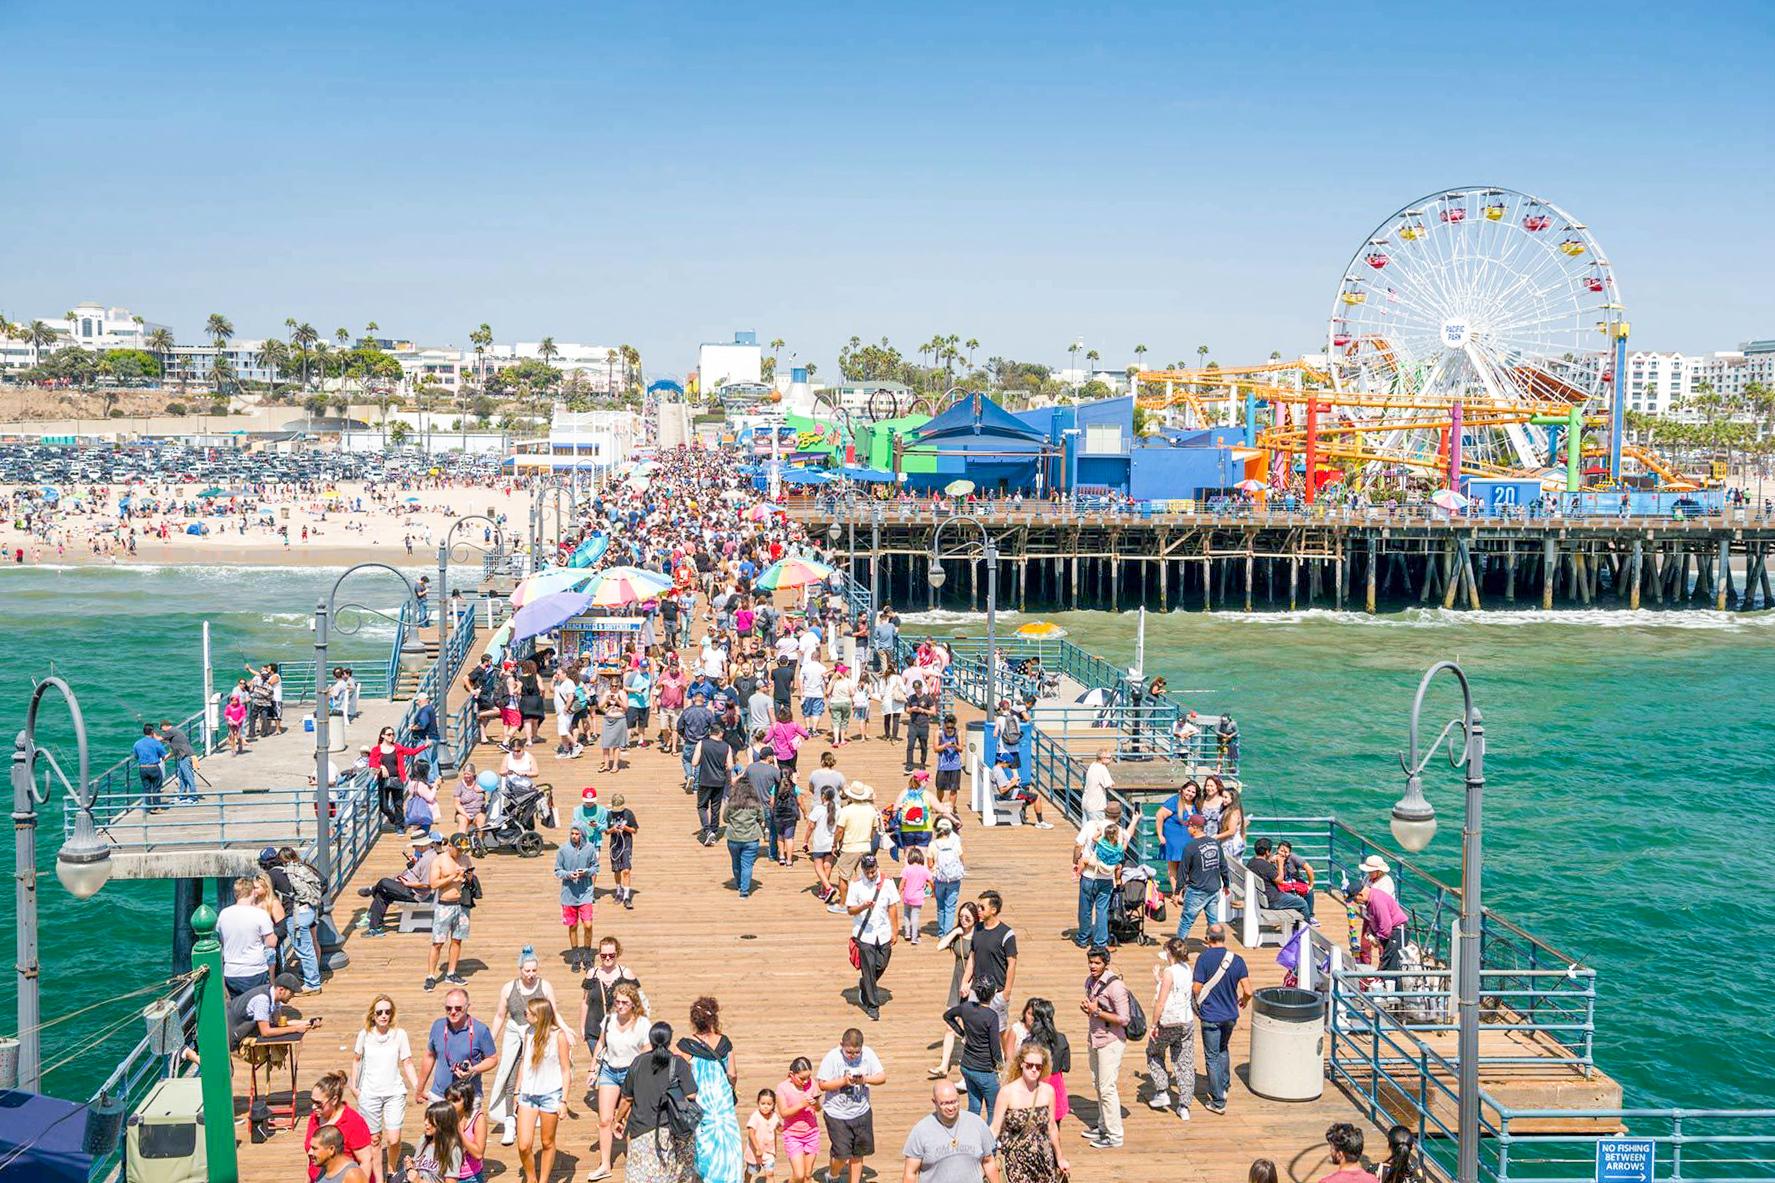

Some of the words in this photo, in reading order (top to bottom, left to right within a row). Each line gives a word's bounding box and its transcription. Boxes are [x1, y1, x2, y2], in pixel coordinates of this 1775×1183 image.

[1446, 325, 1465, 333] PACIFIC
[1448, 333, 1461, 341] PARK
[1495, 486, 1515, 506] 20
[1602, 1144, 1616, 1152] NO
[1617, 1144, 1650, 1153] FISHING
[1605, 1153, 1646, 1162] BETWEEN
[1606, 1162, 1645, 1171] ARROWS
